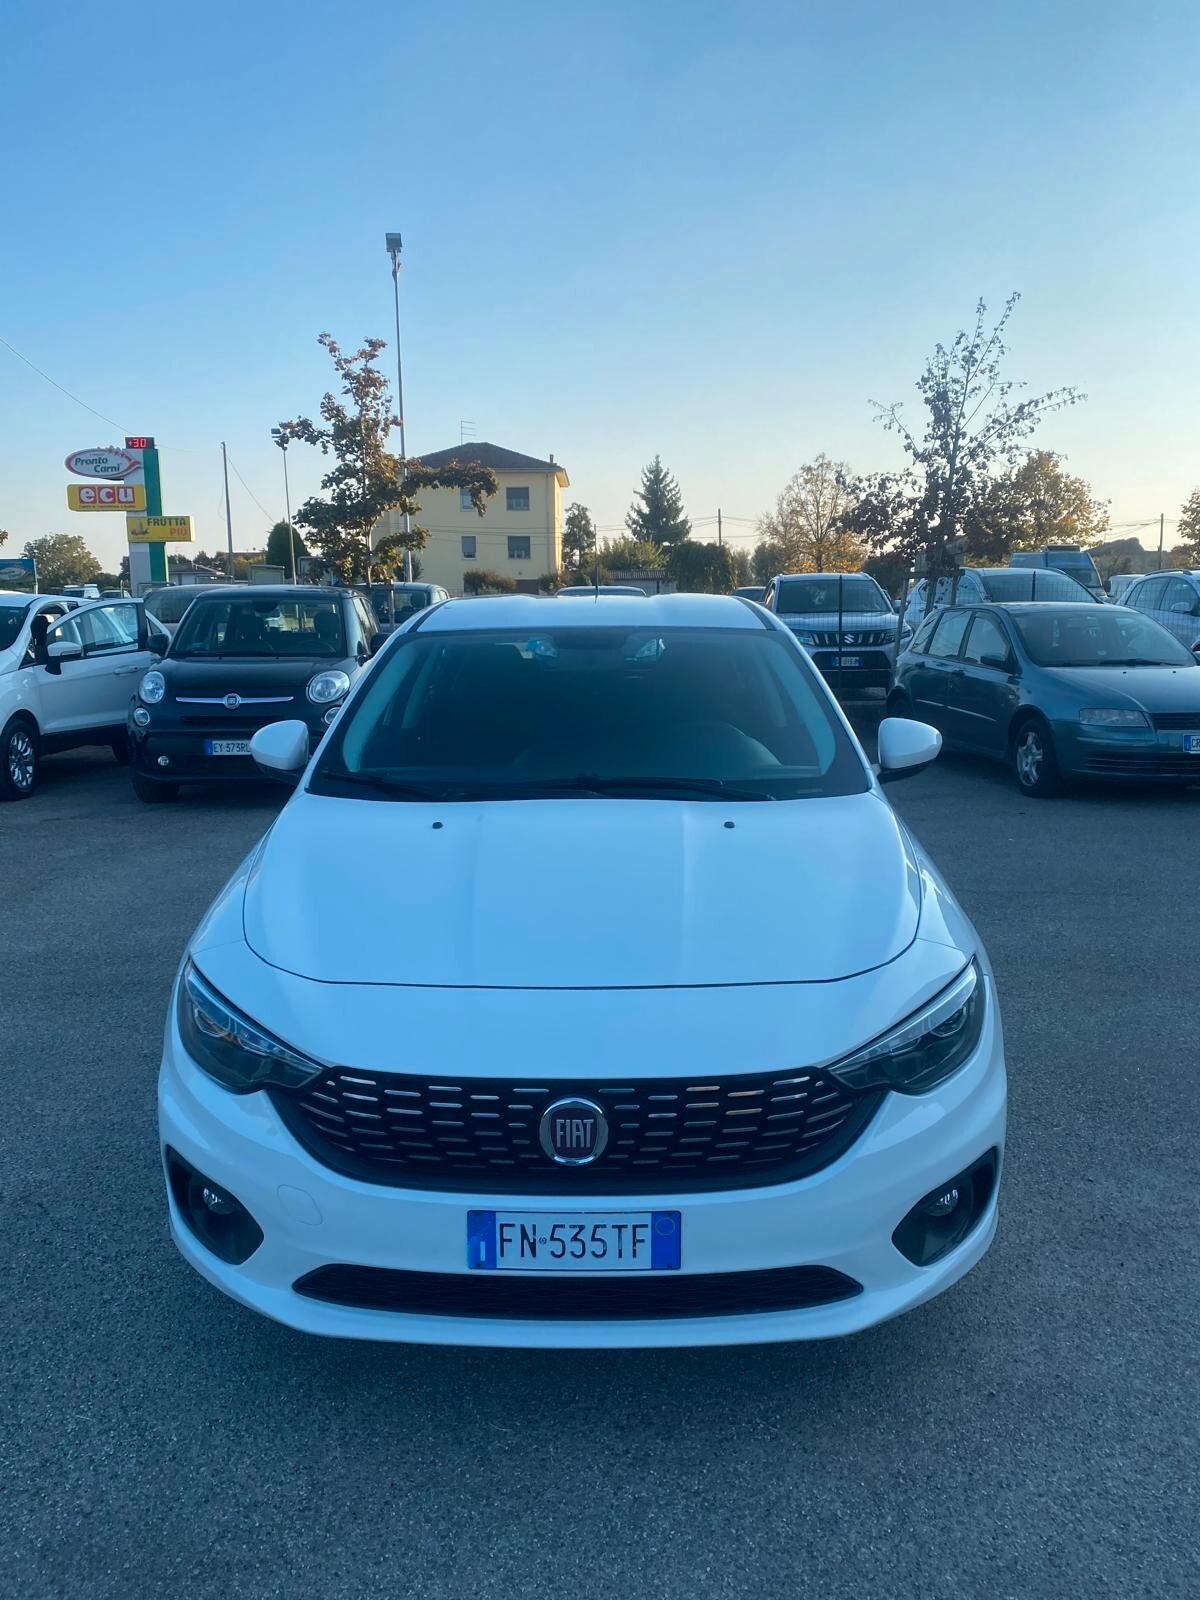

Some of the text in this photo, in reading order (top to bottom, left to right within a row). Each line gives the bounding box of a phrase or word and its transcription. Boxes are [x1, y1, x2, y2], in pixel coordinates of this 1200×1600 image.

[74, 457, 108, 466] Pronto
[94, 464, 120, 473] Carni
[79, 487, 135, 503] ecu
[147, 518, 186, 526] FRUTTA
[556, 1119, 594, 1148] FIAT
